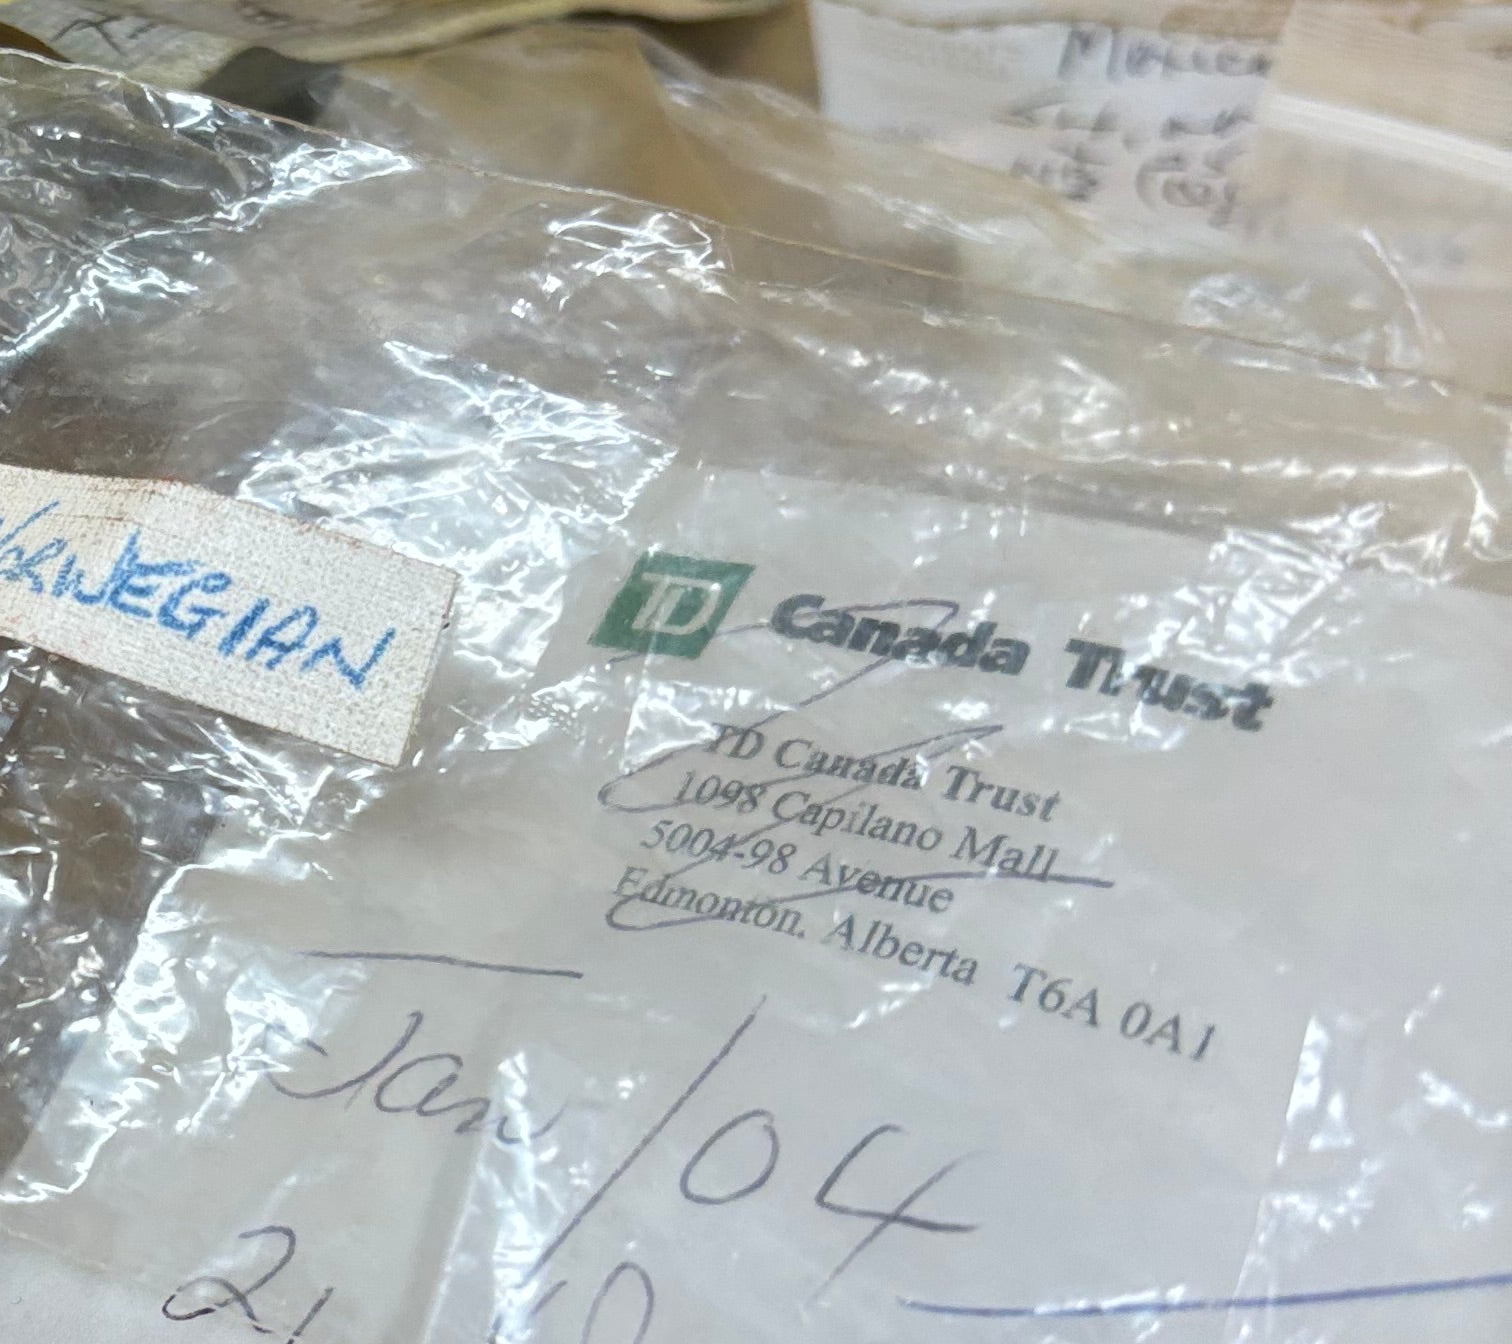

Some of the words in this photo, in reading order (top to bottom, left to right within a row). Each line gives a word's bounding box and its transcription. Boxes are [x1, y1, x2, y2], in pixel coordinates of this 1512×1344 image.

[769, 593, 1031, 678] Canada
[1063, 637, 1275, 732] Trust
[704, 722, 765, 760] TD
[775, 738, 925, 792] Canada
[943, 764, 1061, 824] Trust
[639, 818, 798, 876] 5004-98
[798, 851, 955, 914] Avenue
[771, 790, 944, 853] Capilano
[951, 824, 1058, 882] Mall
[823, 913, 981, 987] Alberta
[1008, 963, 1102, 1028] T6A
